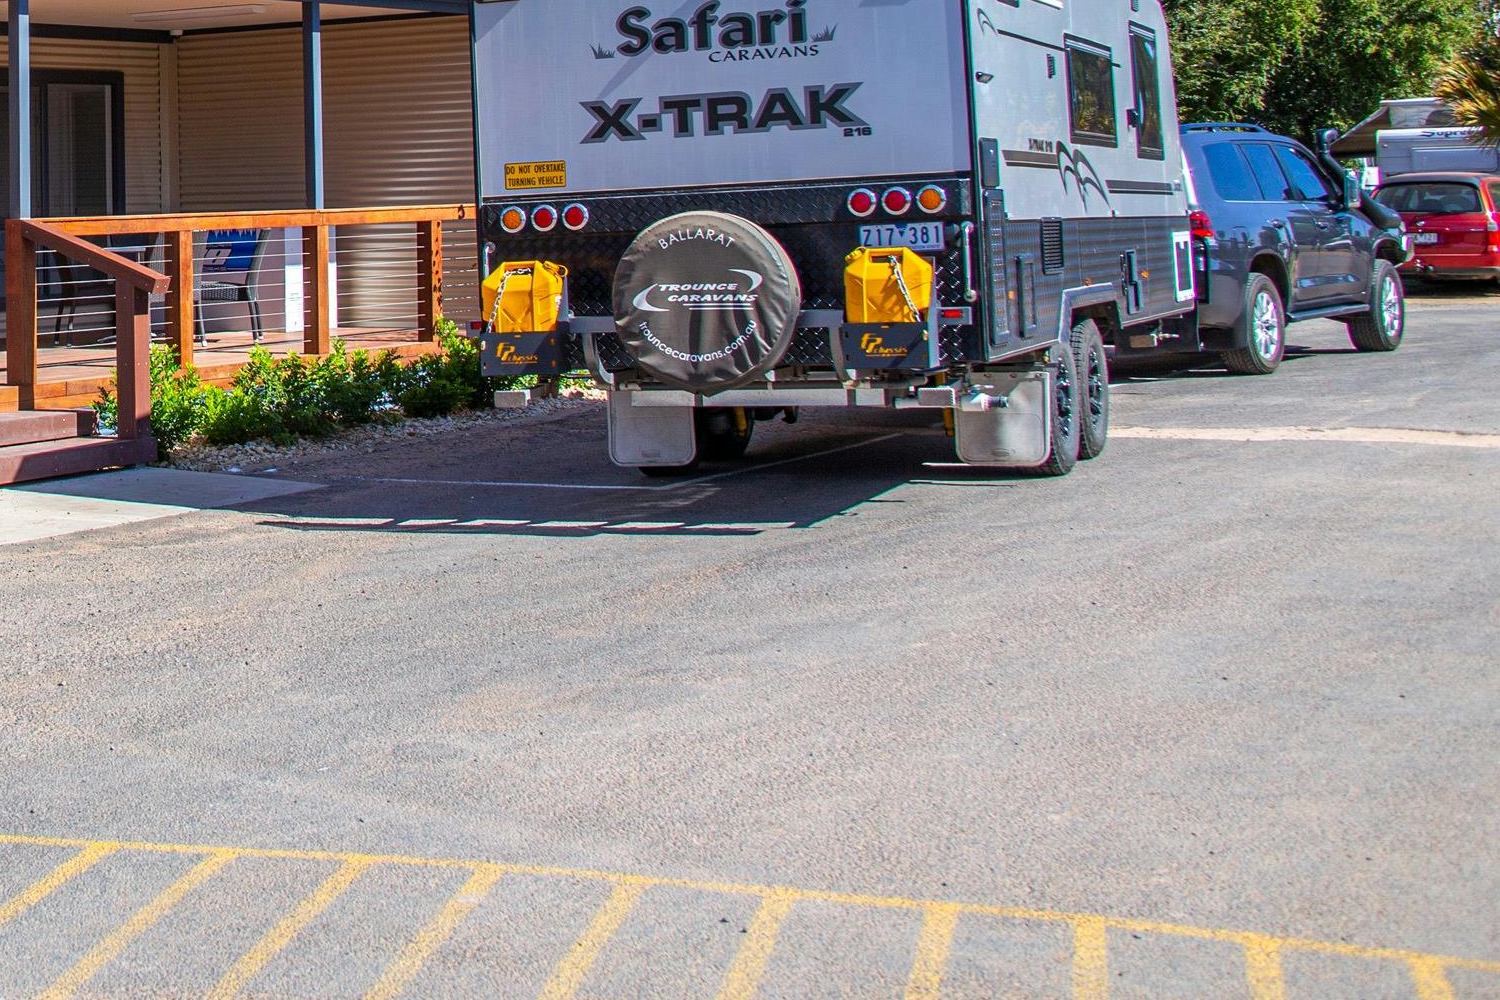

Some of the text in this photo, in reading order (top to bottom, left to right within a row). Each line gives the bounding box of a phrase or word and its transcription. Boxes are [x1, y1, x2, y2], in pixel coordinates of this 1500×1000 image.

[708, 44, 819, 62] CARAVANS
[579, 81, 870, 144] X-TRAK
[506, 163, 565, 174] DO NOT OVERTAKE
[508, 176, 563, 187] TURNING VEHICLE
[658, 228, 735, 249] BALLARAT
[658, 283, 738, 292] TROUNCE
[667, 294, 759, 302] CARAVANS
[639, 319, 757, 362] trouncecaravans.com.au
